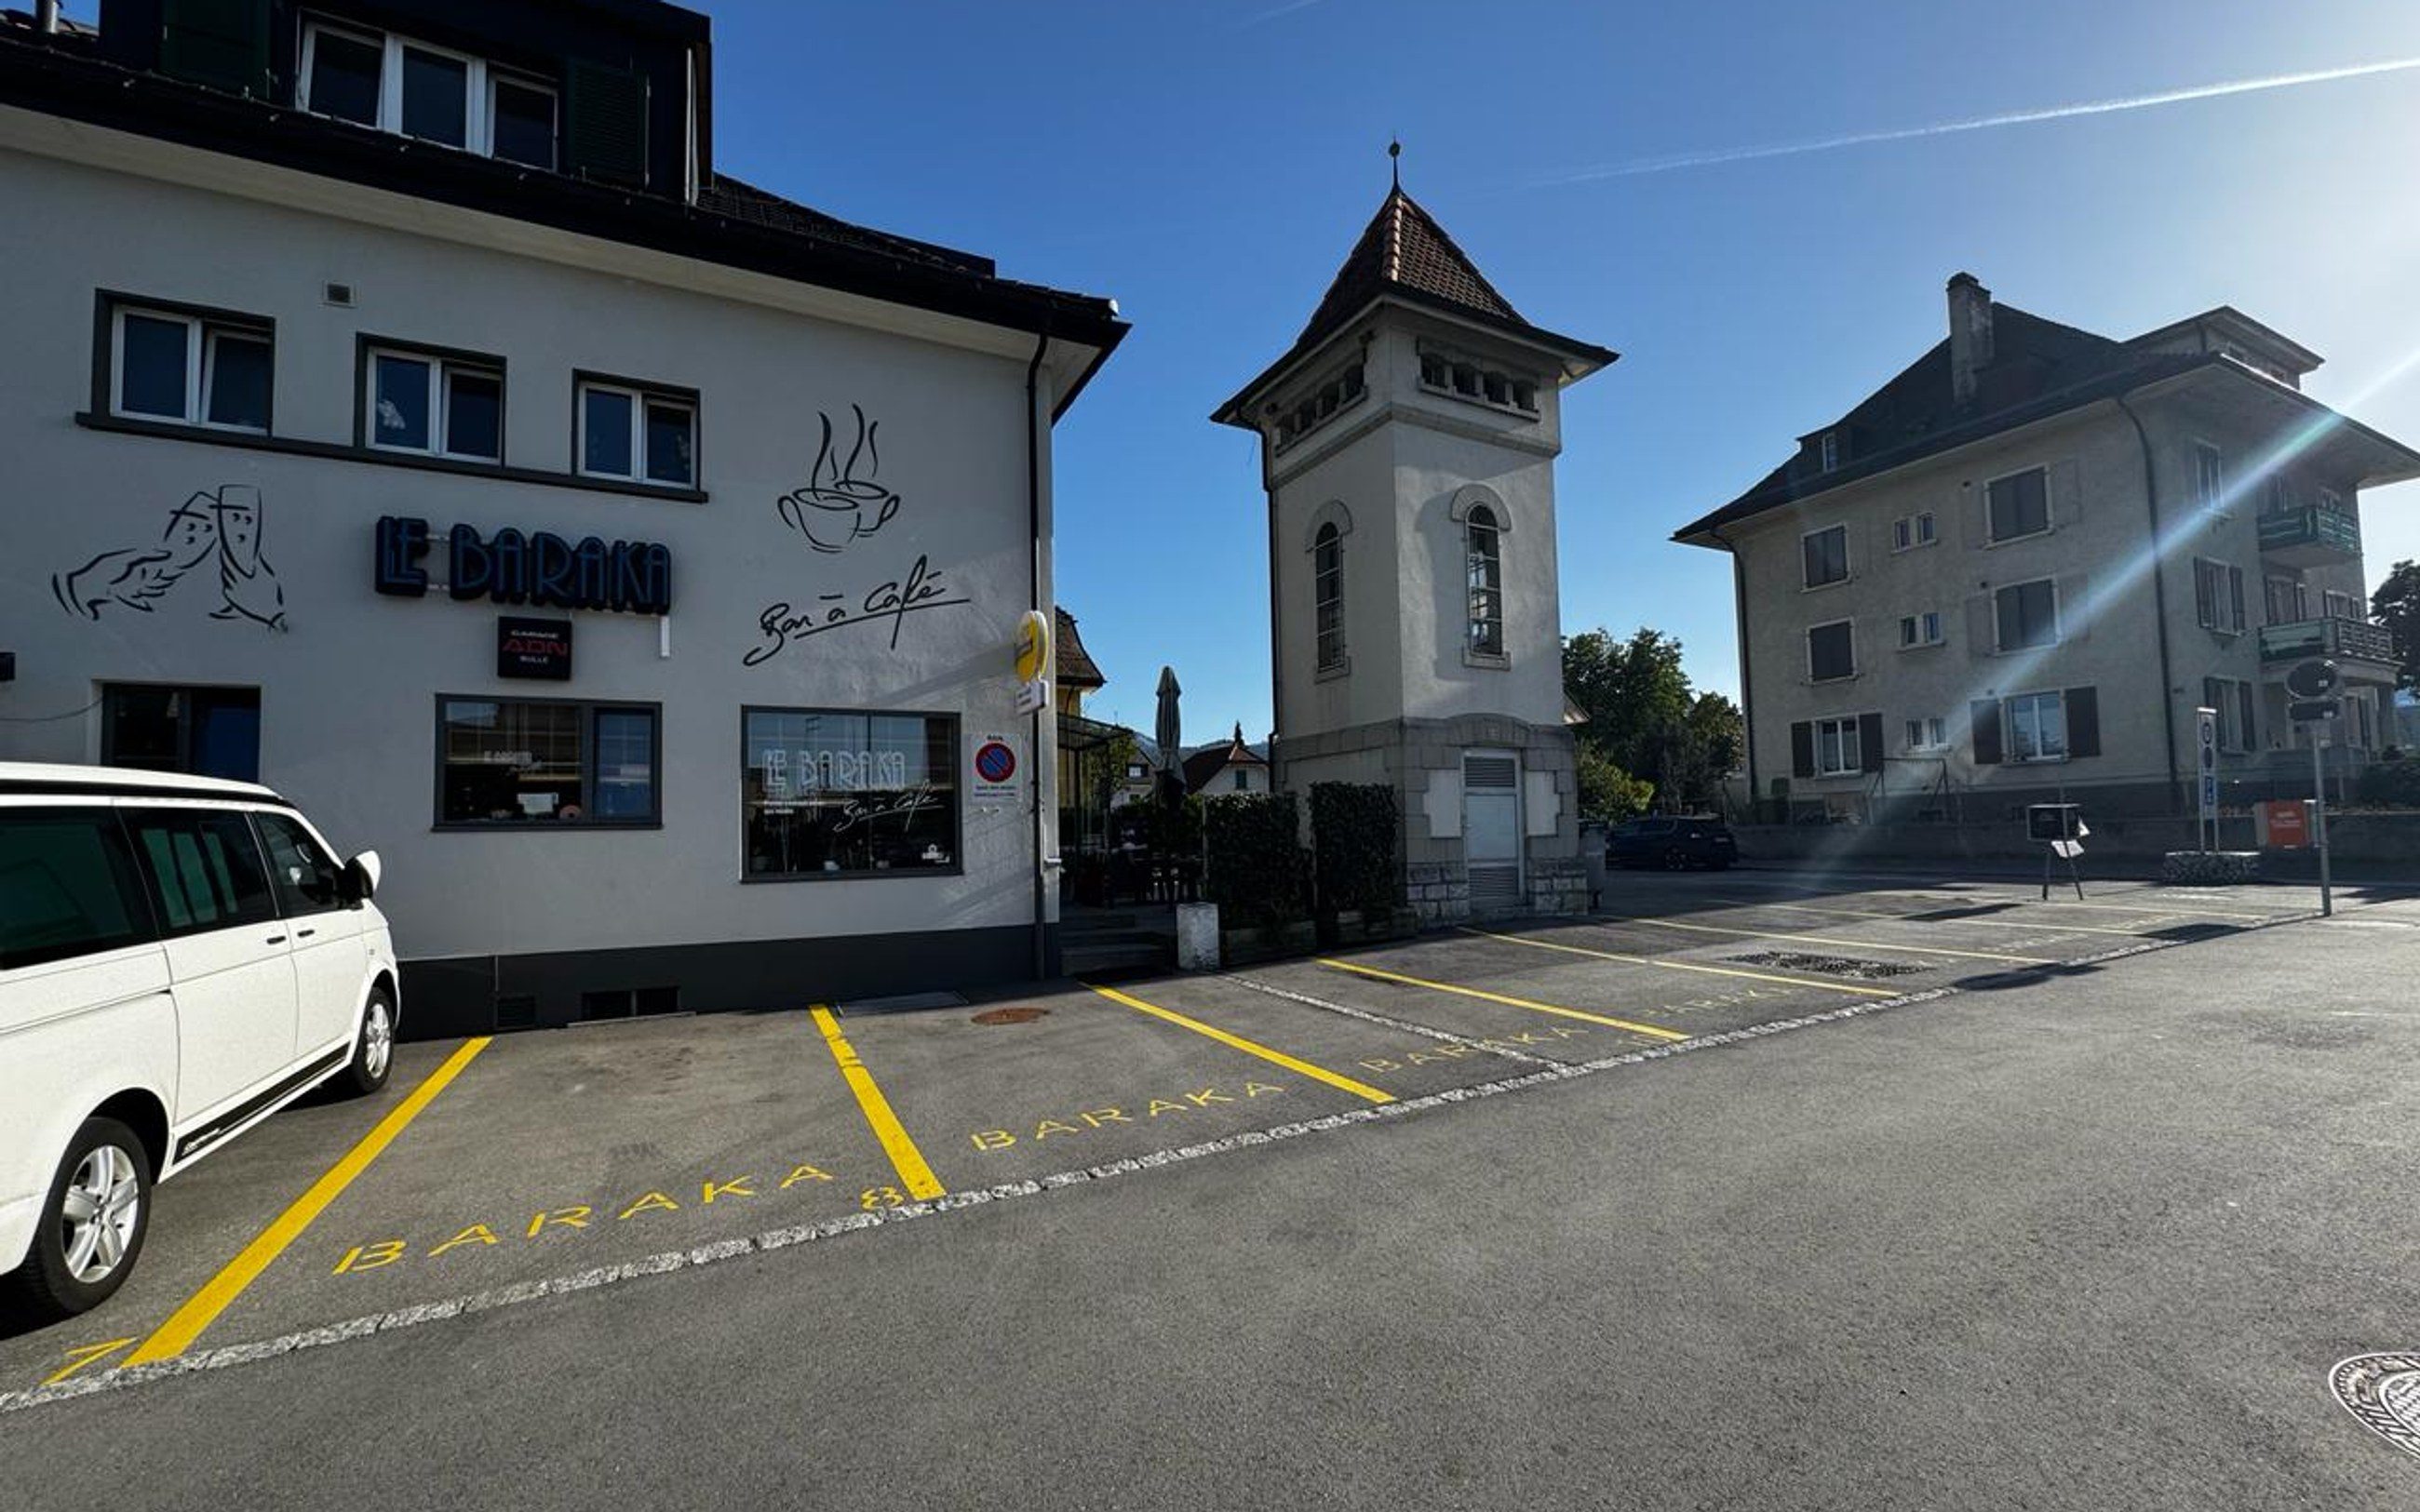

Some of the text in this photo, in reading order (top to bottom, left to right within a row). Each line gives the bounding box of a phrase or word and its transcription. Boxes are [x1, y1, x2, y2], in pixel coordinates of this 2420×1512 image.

[375, 515, 671, 615] LE BARAKA
[743, 603, 813, 666] Bar
[762, 749, 906, 794] LE BARAKA
[971, 1081, 1284, 1151] BARAKA
[331, 1164, 834, 1276] BARAKA
[860, 1186, 905, 1211] 8
